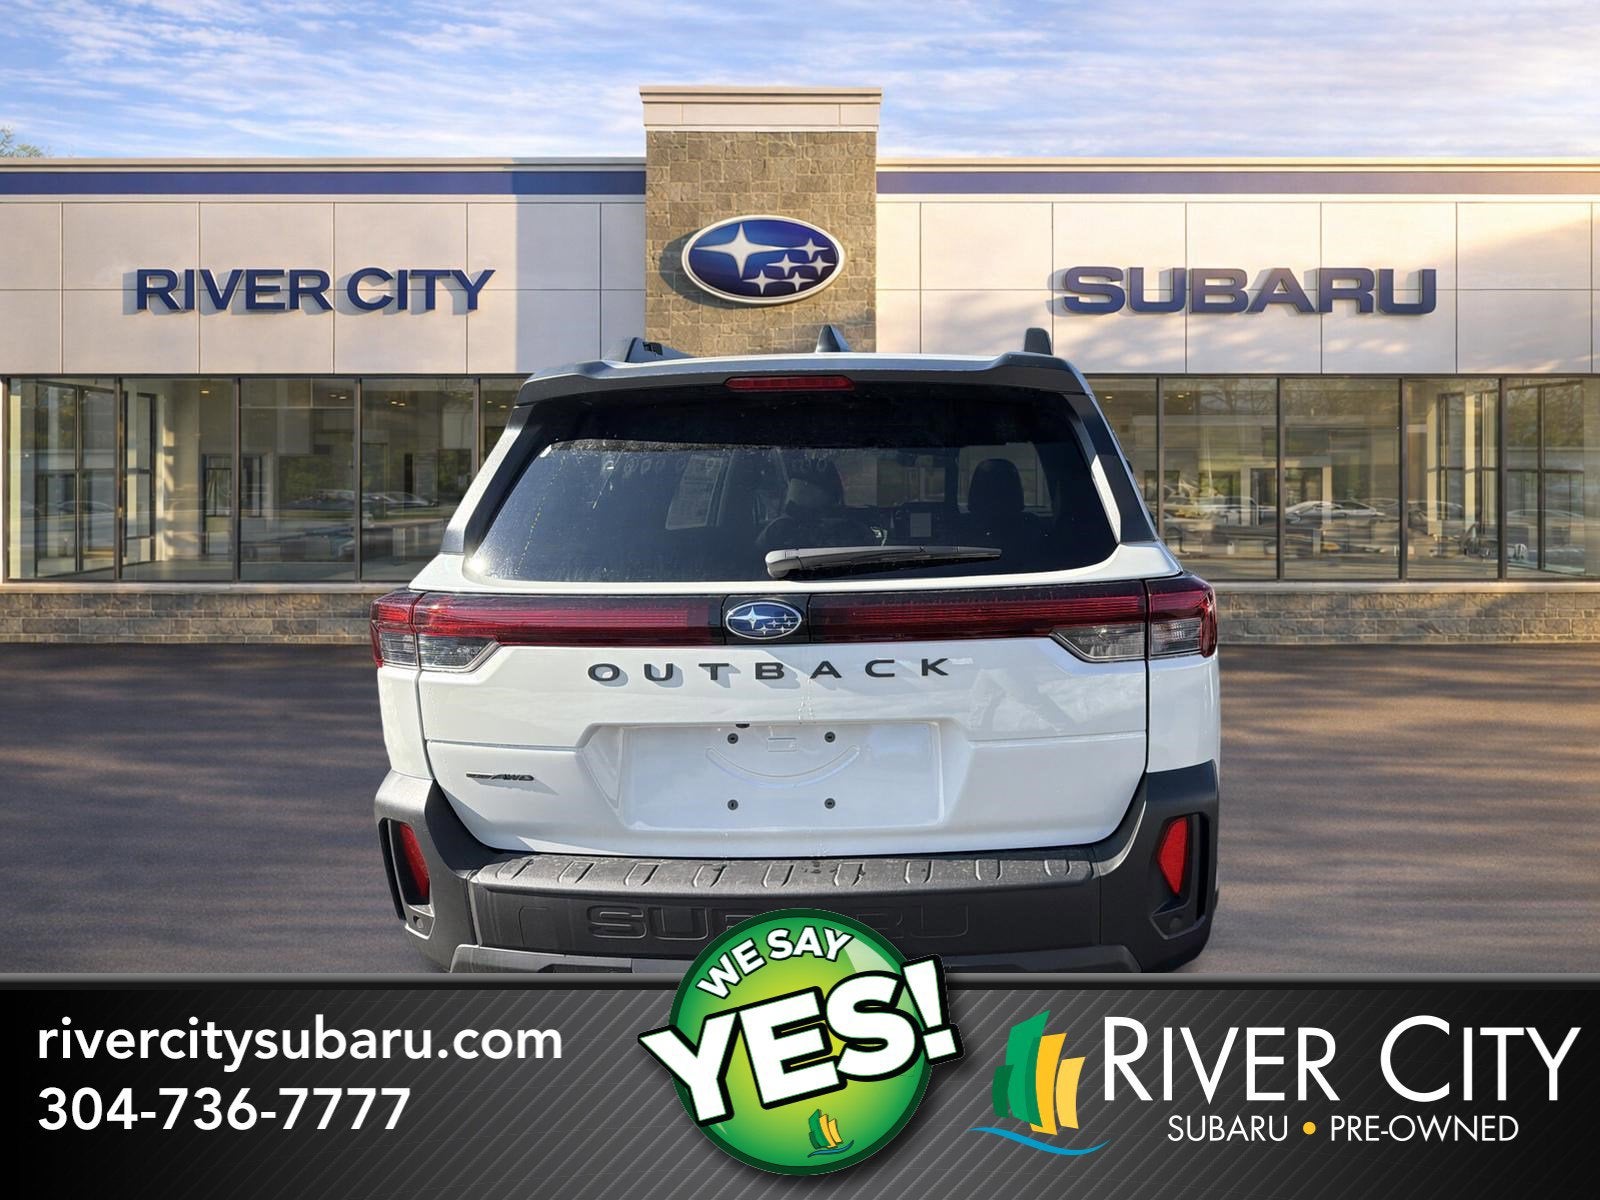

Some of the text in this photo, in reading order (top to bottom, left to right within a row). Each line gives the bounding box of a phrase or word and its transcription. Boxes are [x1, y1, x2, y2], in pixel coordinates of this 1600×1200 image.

[136, 267, 496, 312] RIVER CITY
[1063, 265, 1437, 315] SUBARU
[587, 657, 950, 683] OUTBACK
